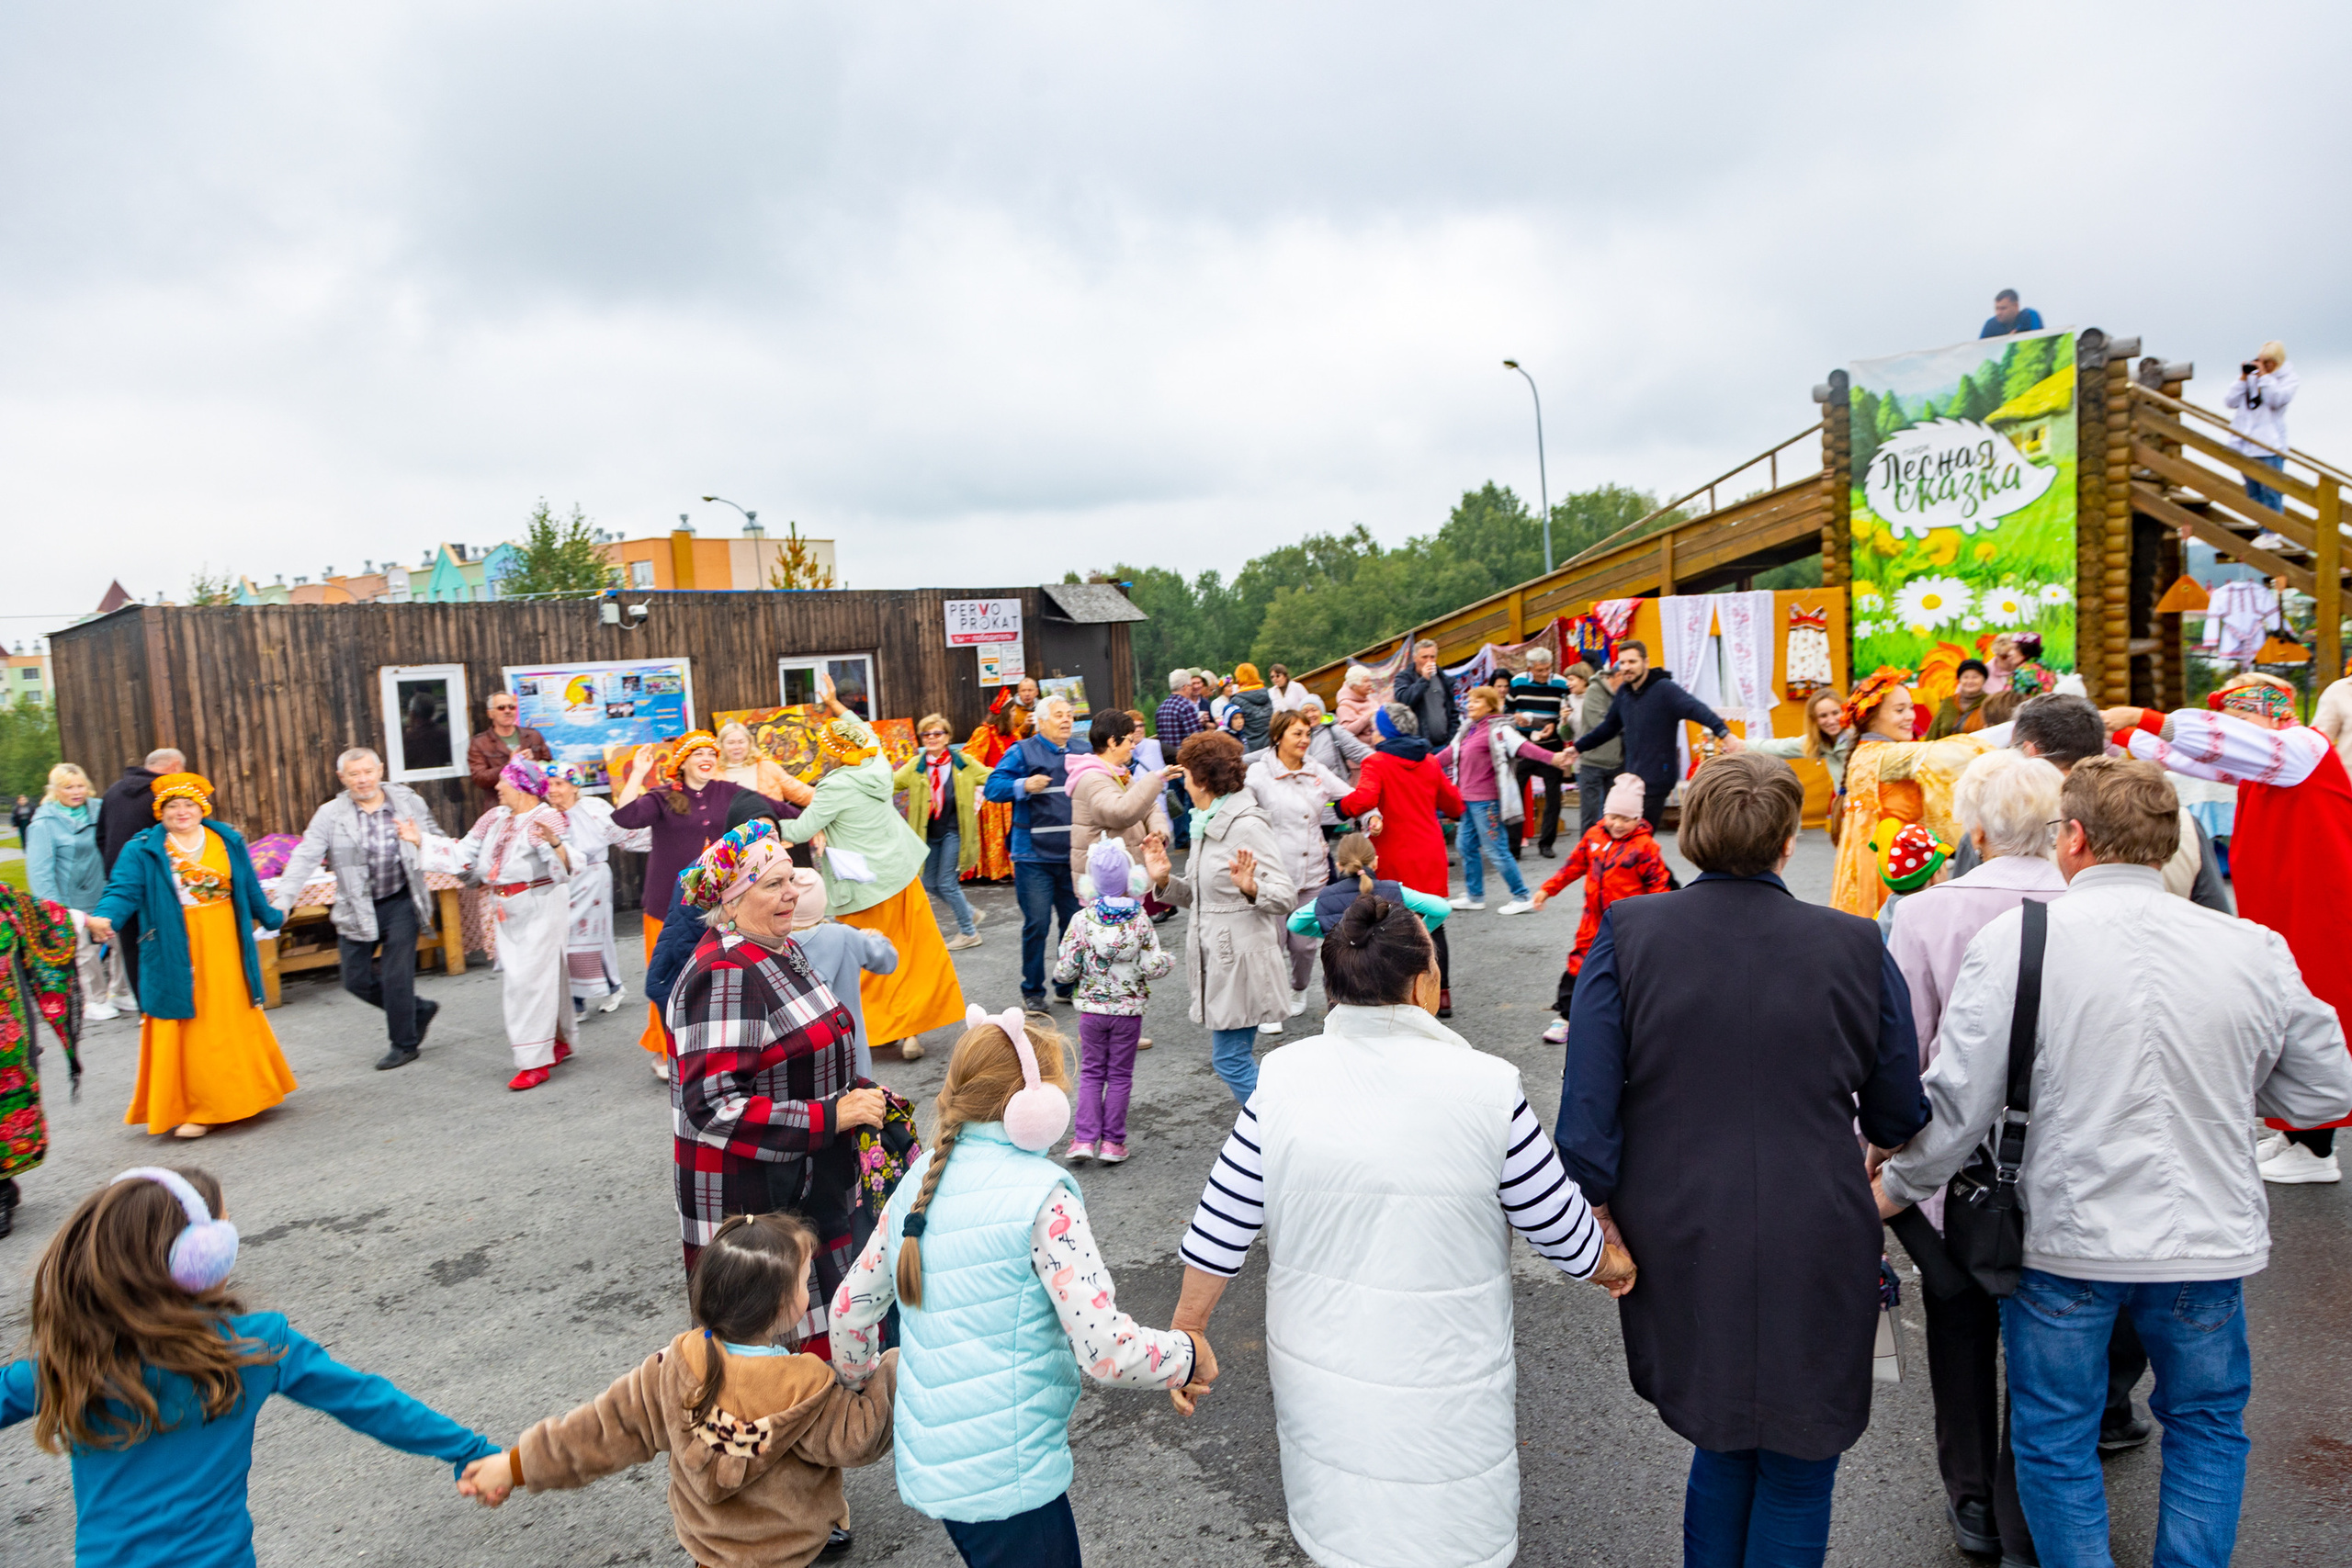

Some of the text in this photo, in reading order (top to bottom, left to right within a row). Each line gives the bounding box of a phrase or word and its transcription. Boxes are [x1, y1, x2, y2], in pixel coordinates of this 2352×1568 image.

[1881, 440, 1995, 490] Лесная
[950, 603, 1001, 616] PERVO
[960, 615, 1018, 630] PROKAT
